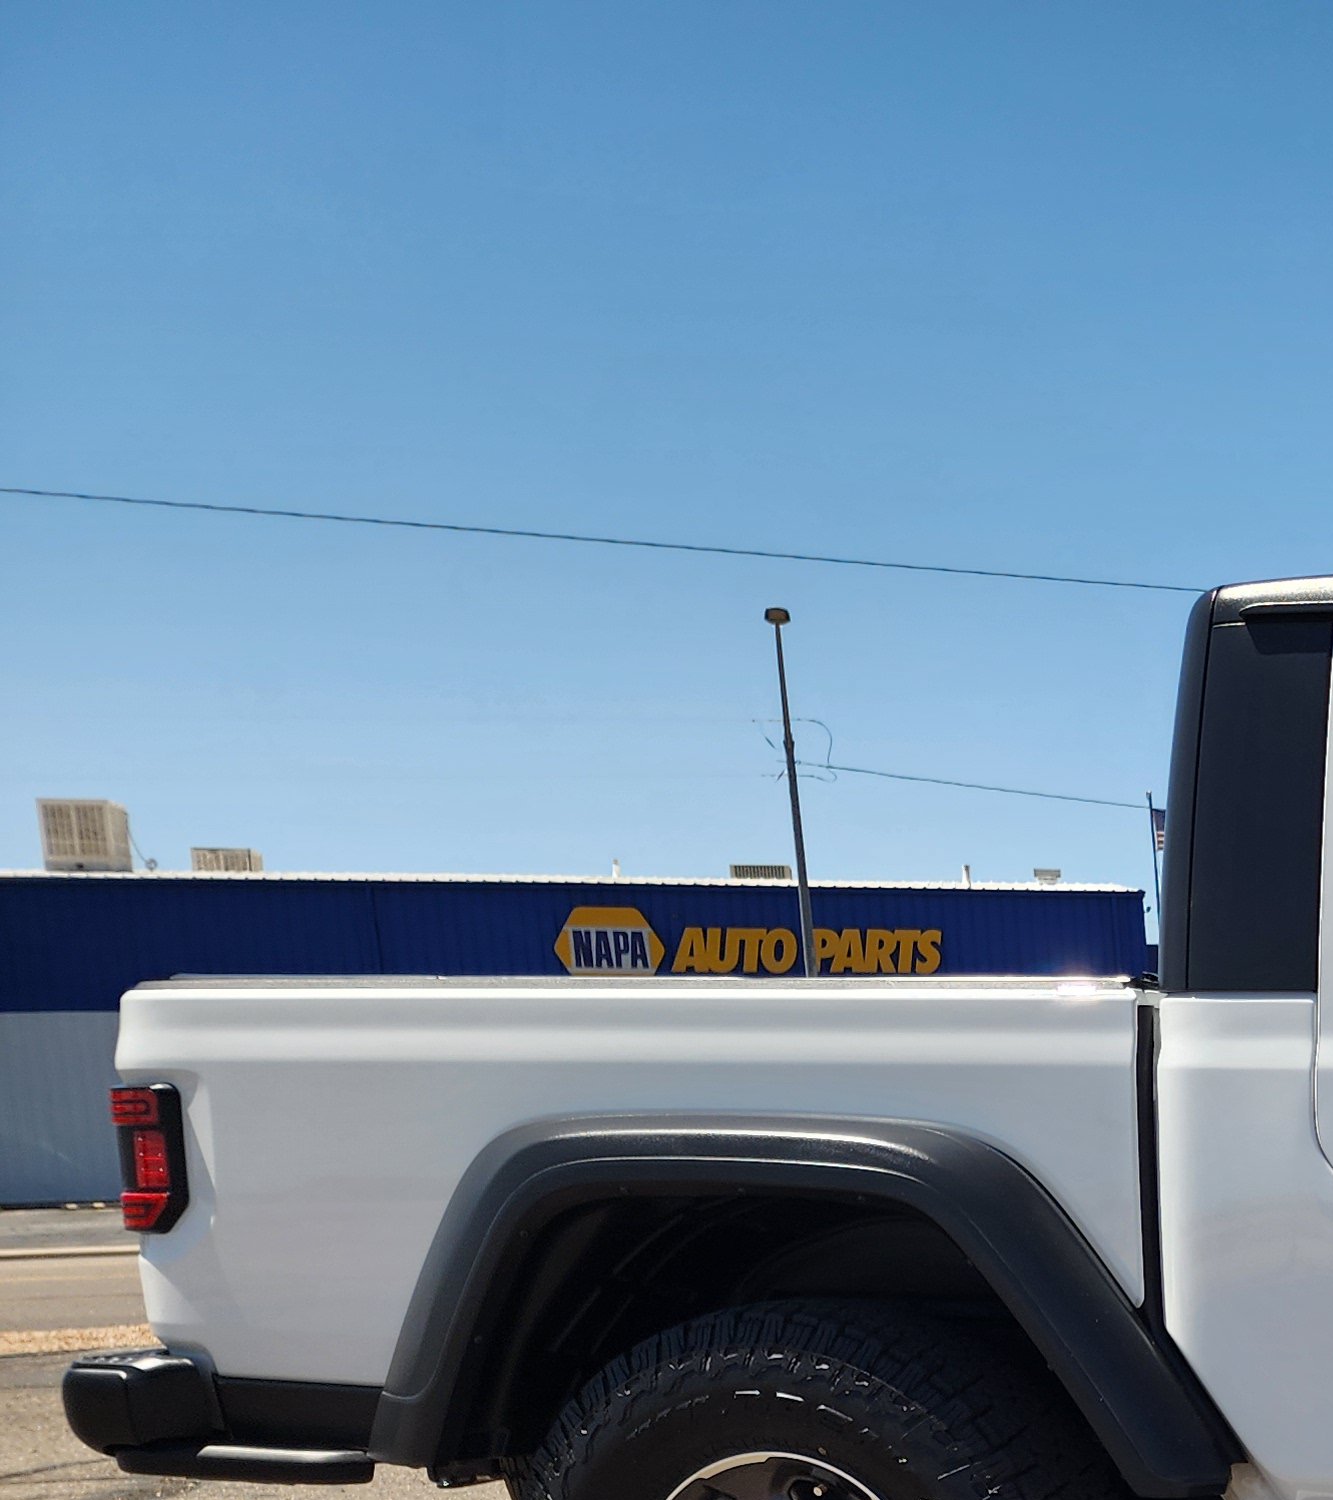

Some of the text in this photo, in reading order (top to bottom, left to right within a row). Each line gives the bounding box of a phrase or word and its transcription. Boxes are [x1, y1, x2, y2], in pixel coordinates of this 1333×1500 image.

[572, 926, 943, 975] NAPA AUTO PARTS
